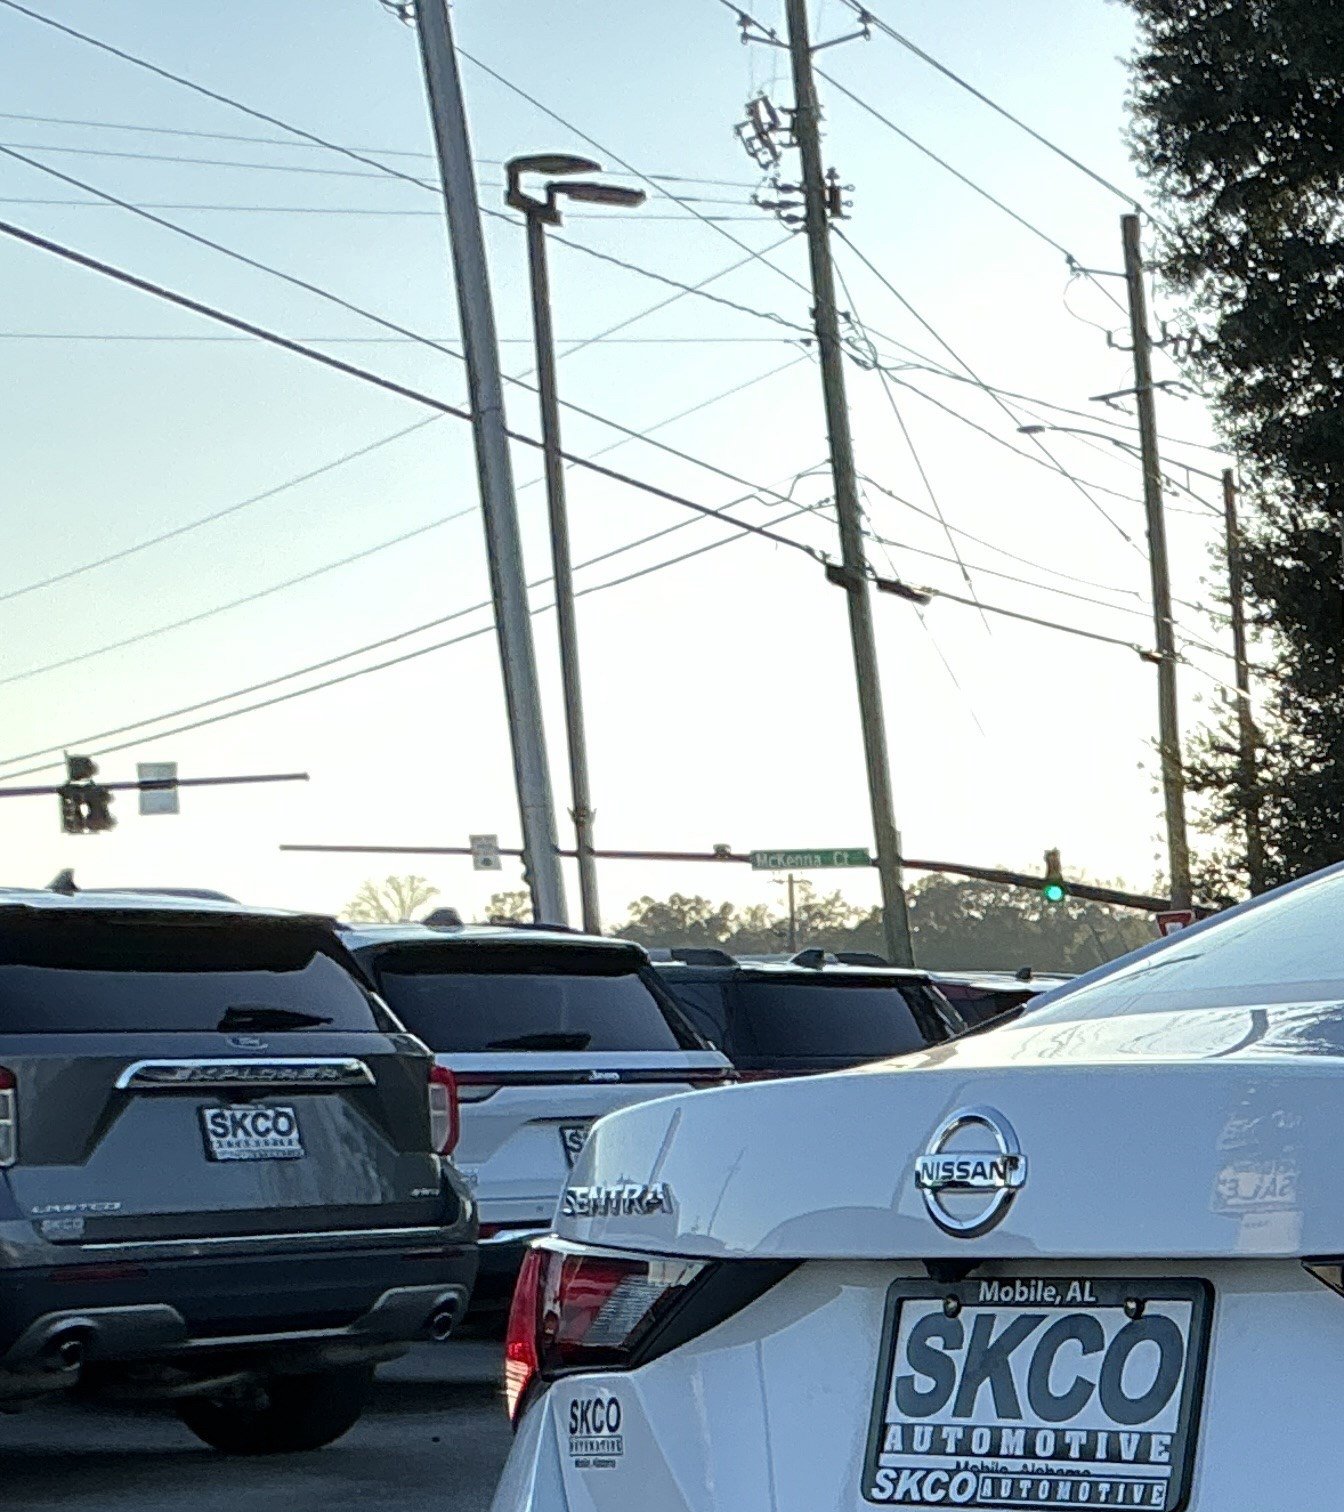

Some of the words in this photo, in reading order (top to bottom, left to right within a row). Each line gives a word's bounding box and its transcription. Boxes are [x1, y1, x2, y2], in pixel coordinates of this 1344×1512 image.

[756, 852, 821, 868] McKenna
[210, 1111, 294, 1138] SKCO
[921, 1161, 1007, 1181] NISSAN
[562, 1182, 673, 1217] SENTRA
[979, 1279, 1061, 1304] Mobile,
[1066, 1280, 1096, 1302] AL
[895, 1312, 1184, 1425] SKCO
[569, 1397, 621, 1435] SKCO
[884, 1425, 1172, 1463] AUTOMOTIVE
[871, 1469, 978, 1502] SKCO
[981, 1478, 1166, 1505] AUTOMOTIVE
